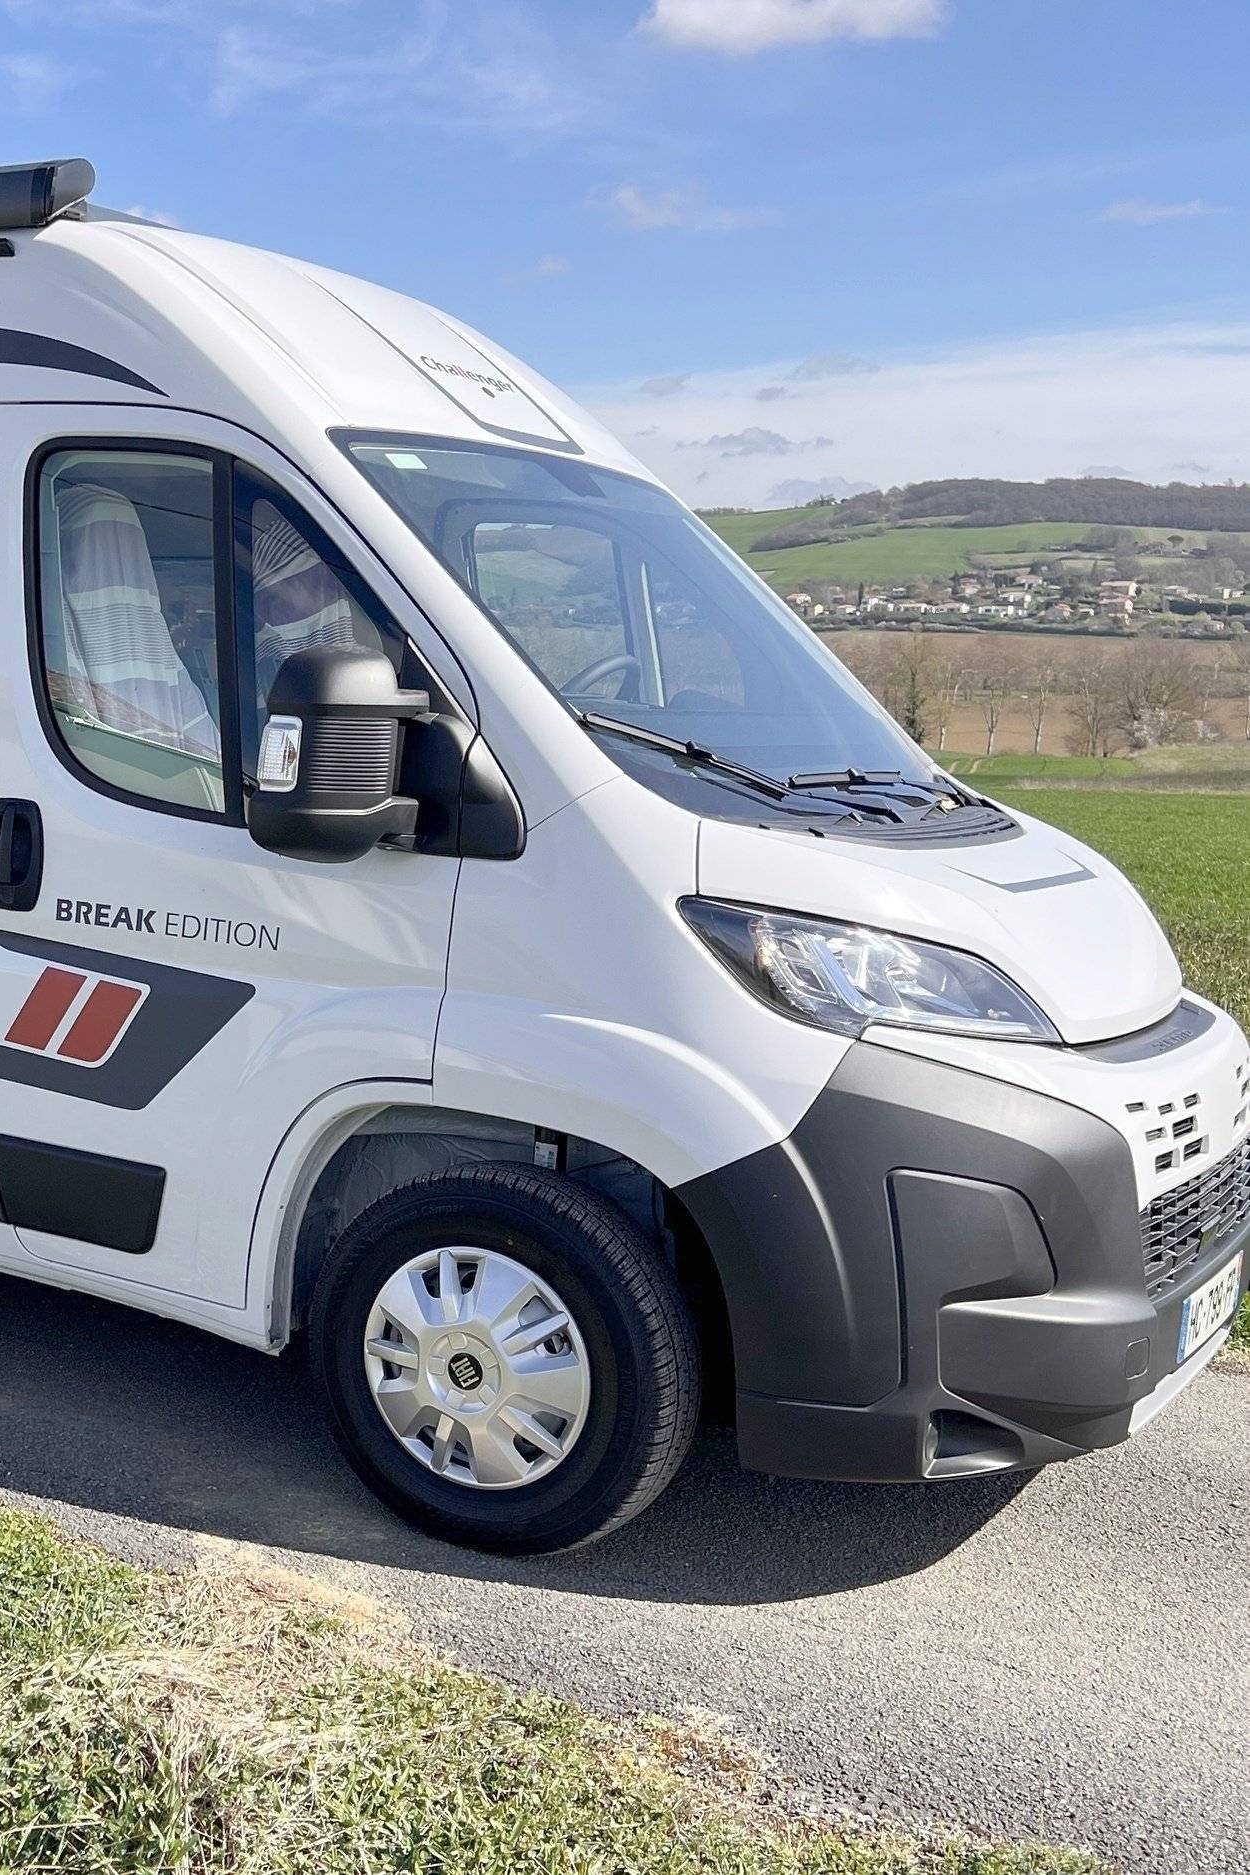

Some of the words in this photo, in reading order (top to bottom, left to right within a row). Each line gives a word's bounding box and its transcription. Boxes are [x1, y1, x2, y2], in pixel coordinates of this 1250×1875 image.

[420, 355, 515, 393] Challenger
[55, 898, 157, 934] BREAK
[165, 912, 281, 952] EDITION
[450, 1356, 480, 1388] FIAT
